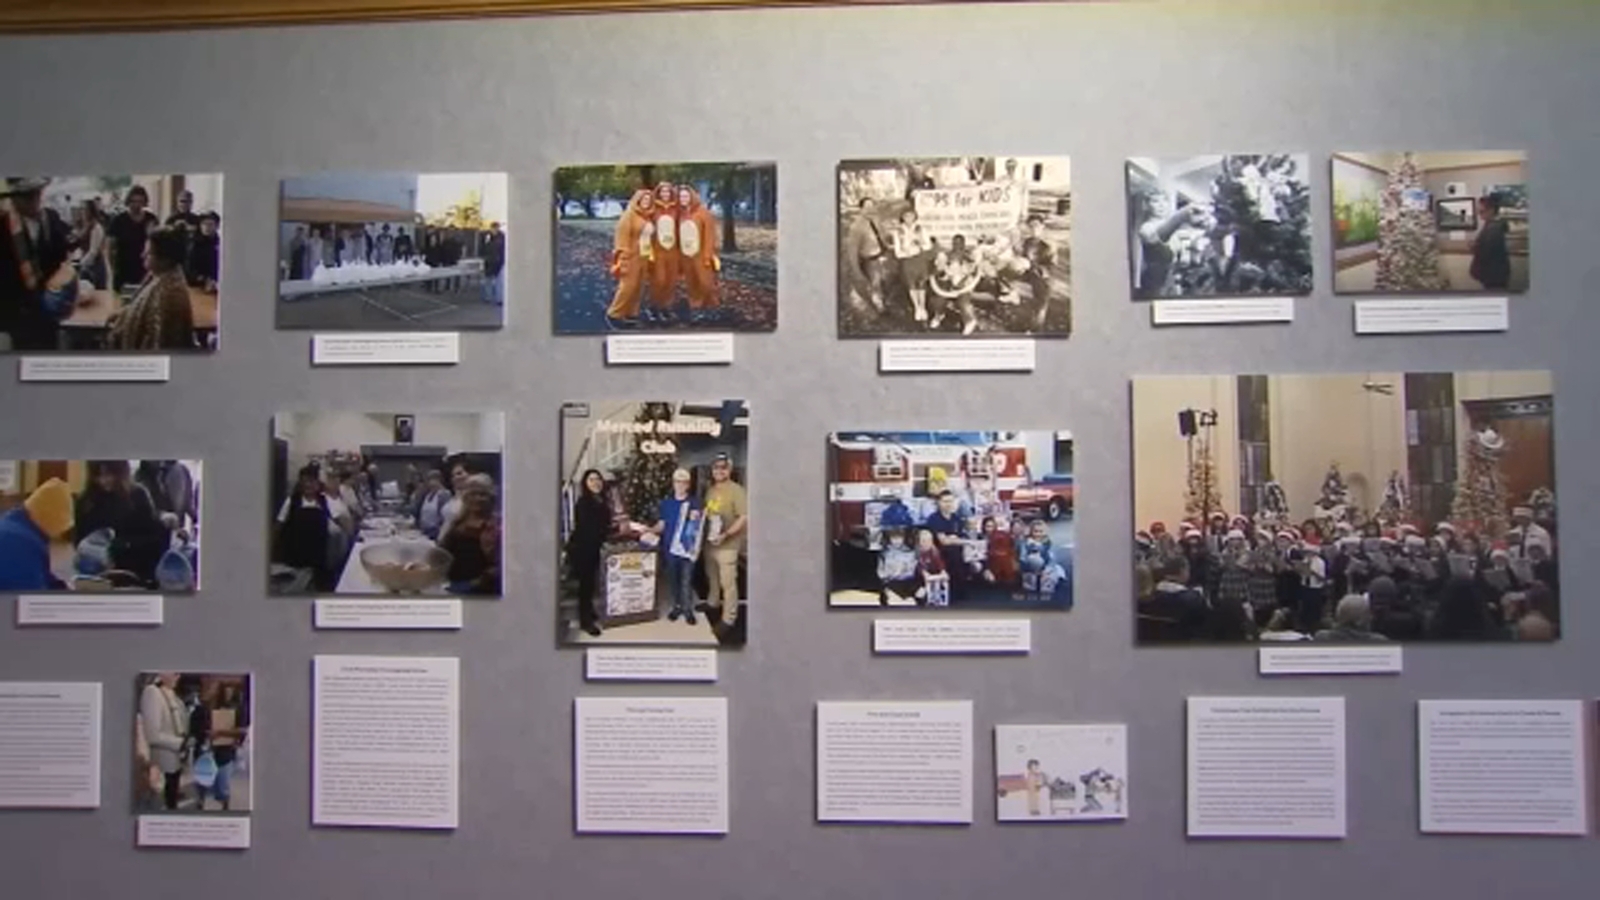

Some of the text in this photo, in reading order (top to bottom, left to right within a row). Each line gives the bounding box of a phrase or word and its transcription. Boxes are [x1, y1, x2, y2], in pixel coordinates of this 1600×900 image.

[955, 191, 973, 207] for
[979, 185, 1011, 203] KIDS
[596, 420, 721, 437] Merced Running
[640, 440, 677, 453] Club
